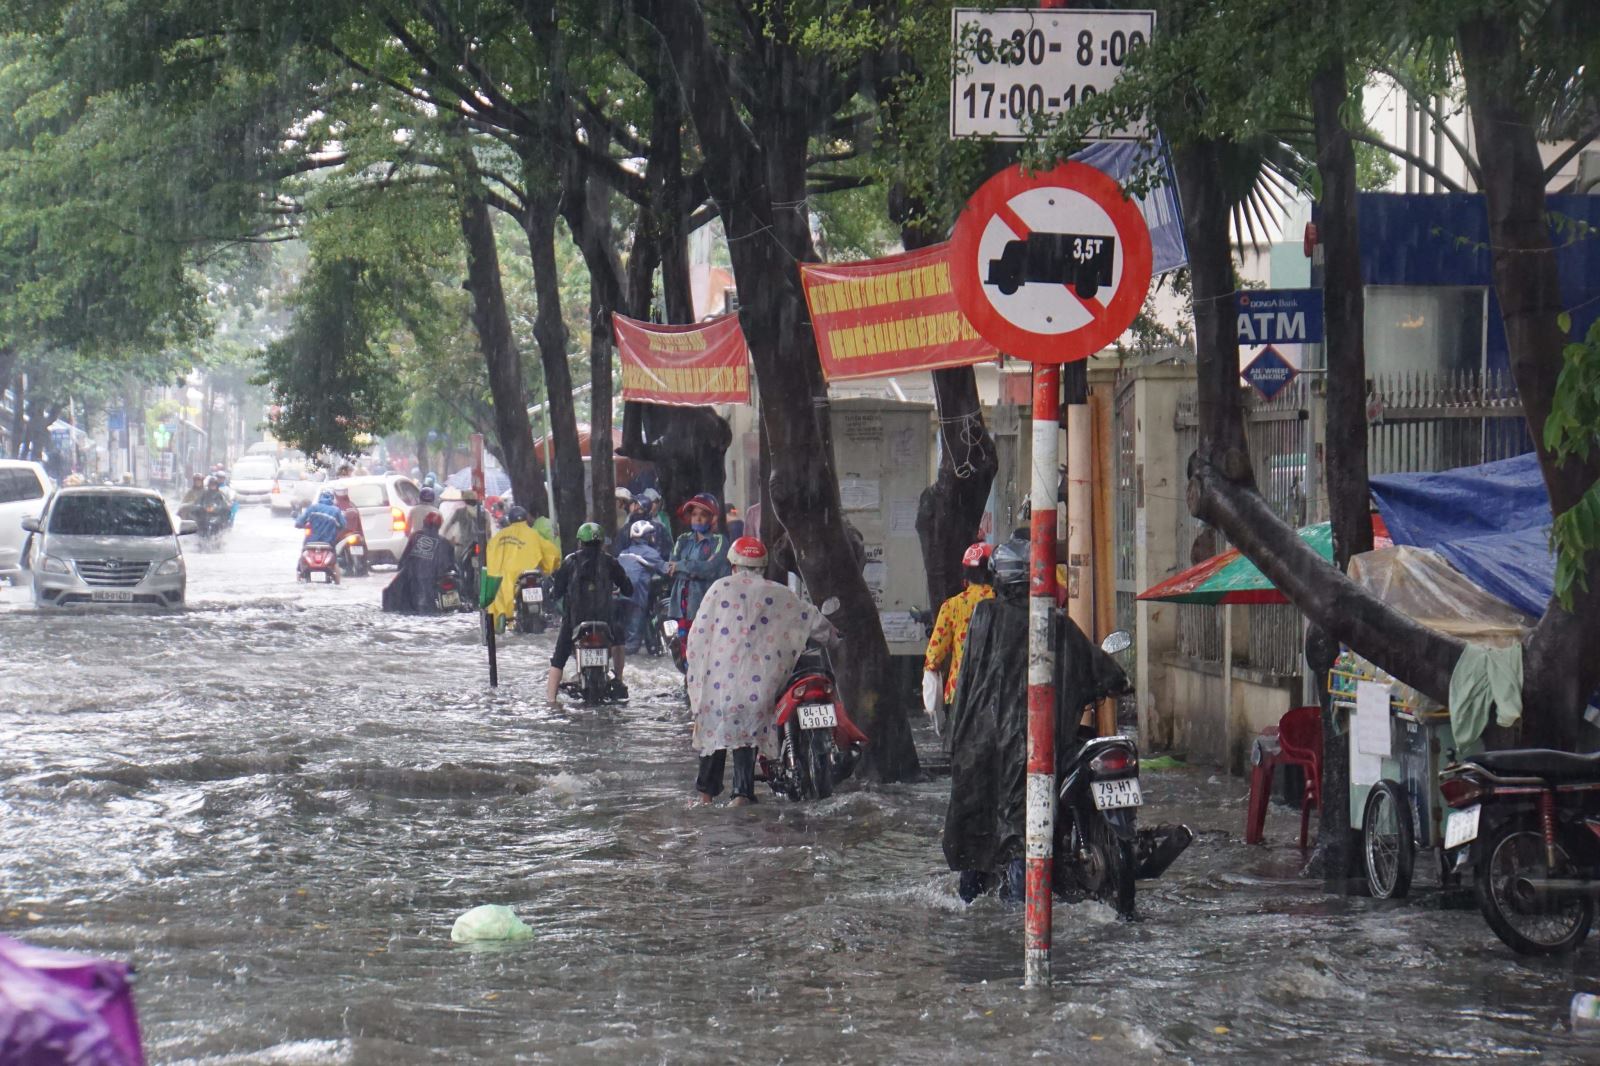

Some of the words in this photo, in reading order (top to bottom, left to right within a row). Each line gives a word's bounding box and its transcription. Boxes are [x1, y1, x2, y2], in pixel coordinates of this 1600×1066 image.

[1073, 238, 1104, 265] 3,5T
[1236, 311, 1306, 341] ATM
[803, 705, 829, 718] 84-L1
[1099, 780, 1132, 795] 79-H1
